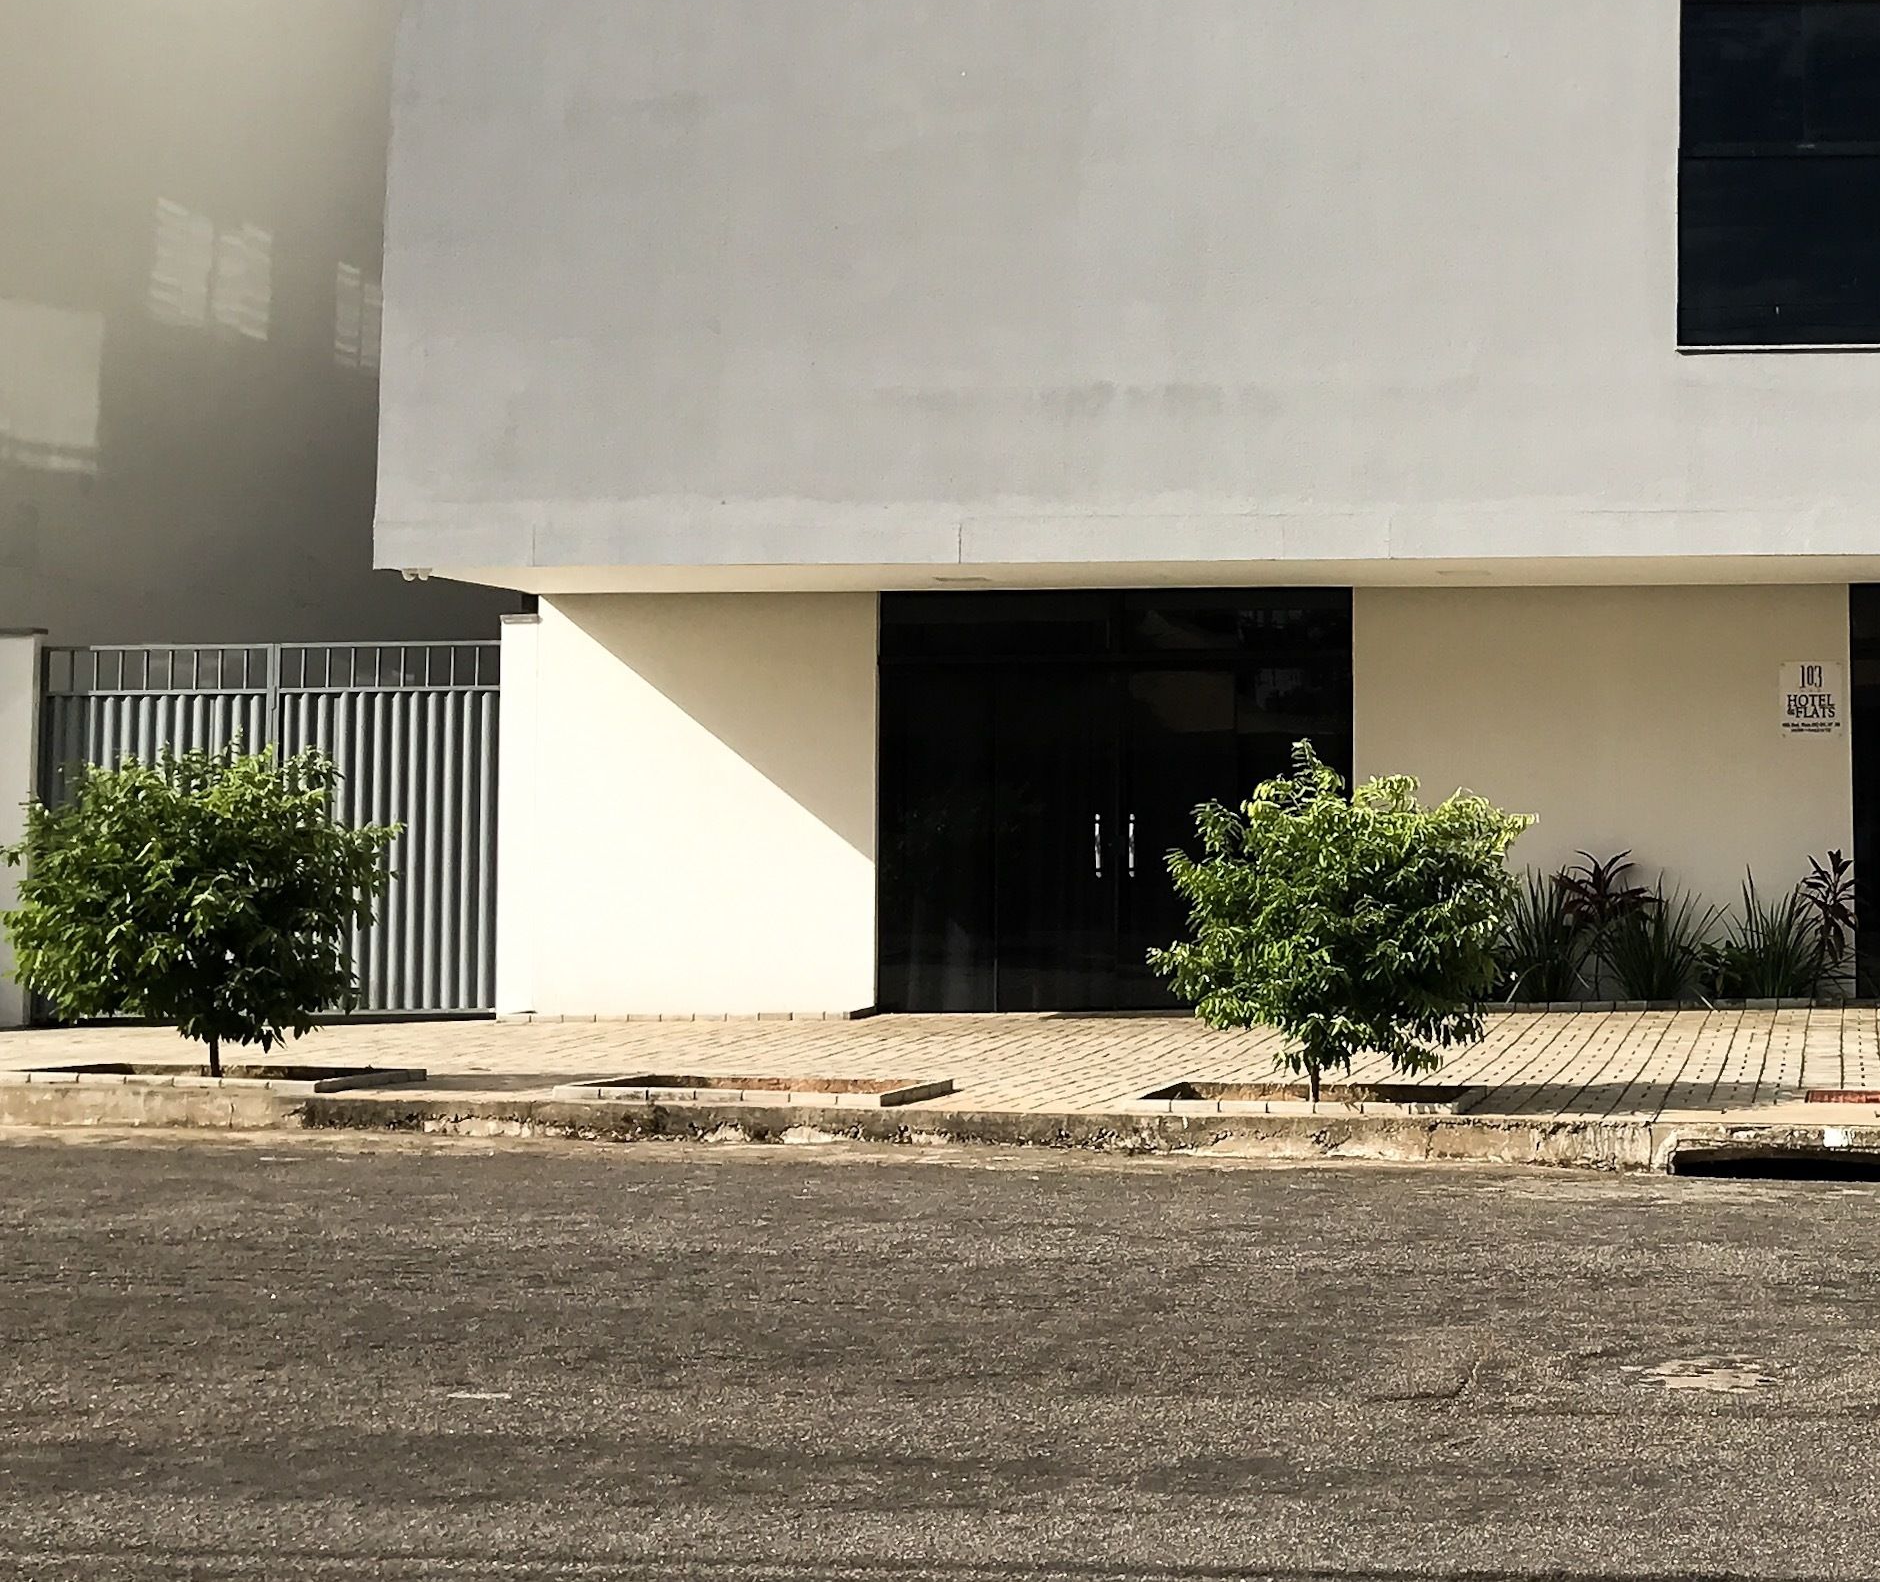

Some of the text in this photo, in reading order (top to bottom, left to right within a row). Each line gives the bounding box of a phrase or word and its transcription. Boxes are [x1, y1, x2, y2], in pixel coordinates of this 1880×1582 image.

[1800, 665, 1822, 688] 103
[1787, 694, 1835, 707] HOTEL
[1796, 706, 1836, 718] FLATS
